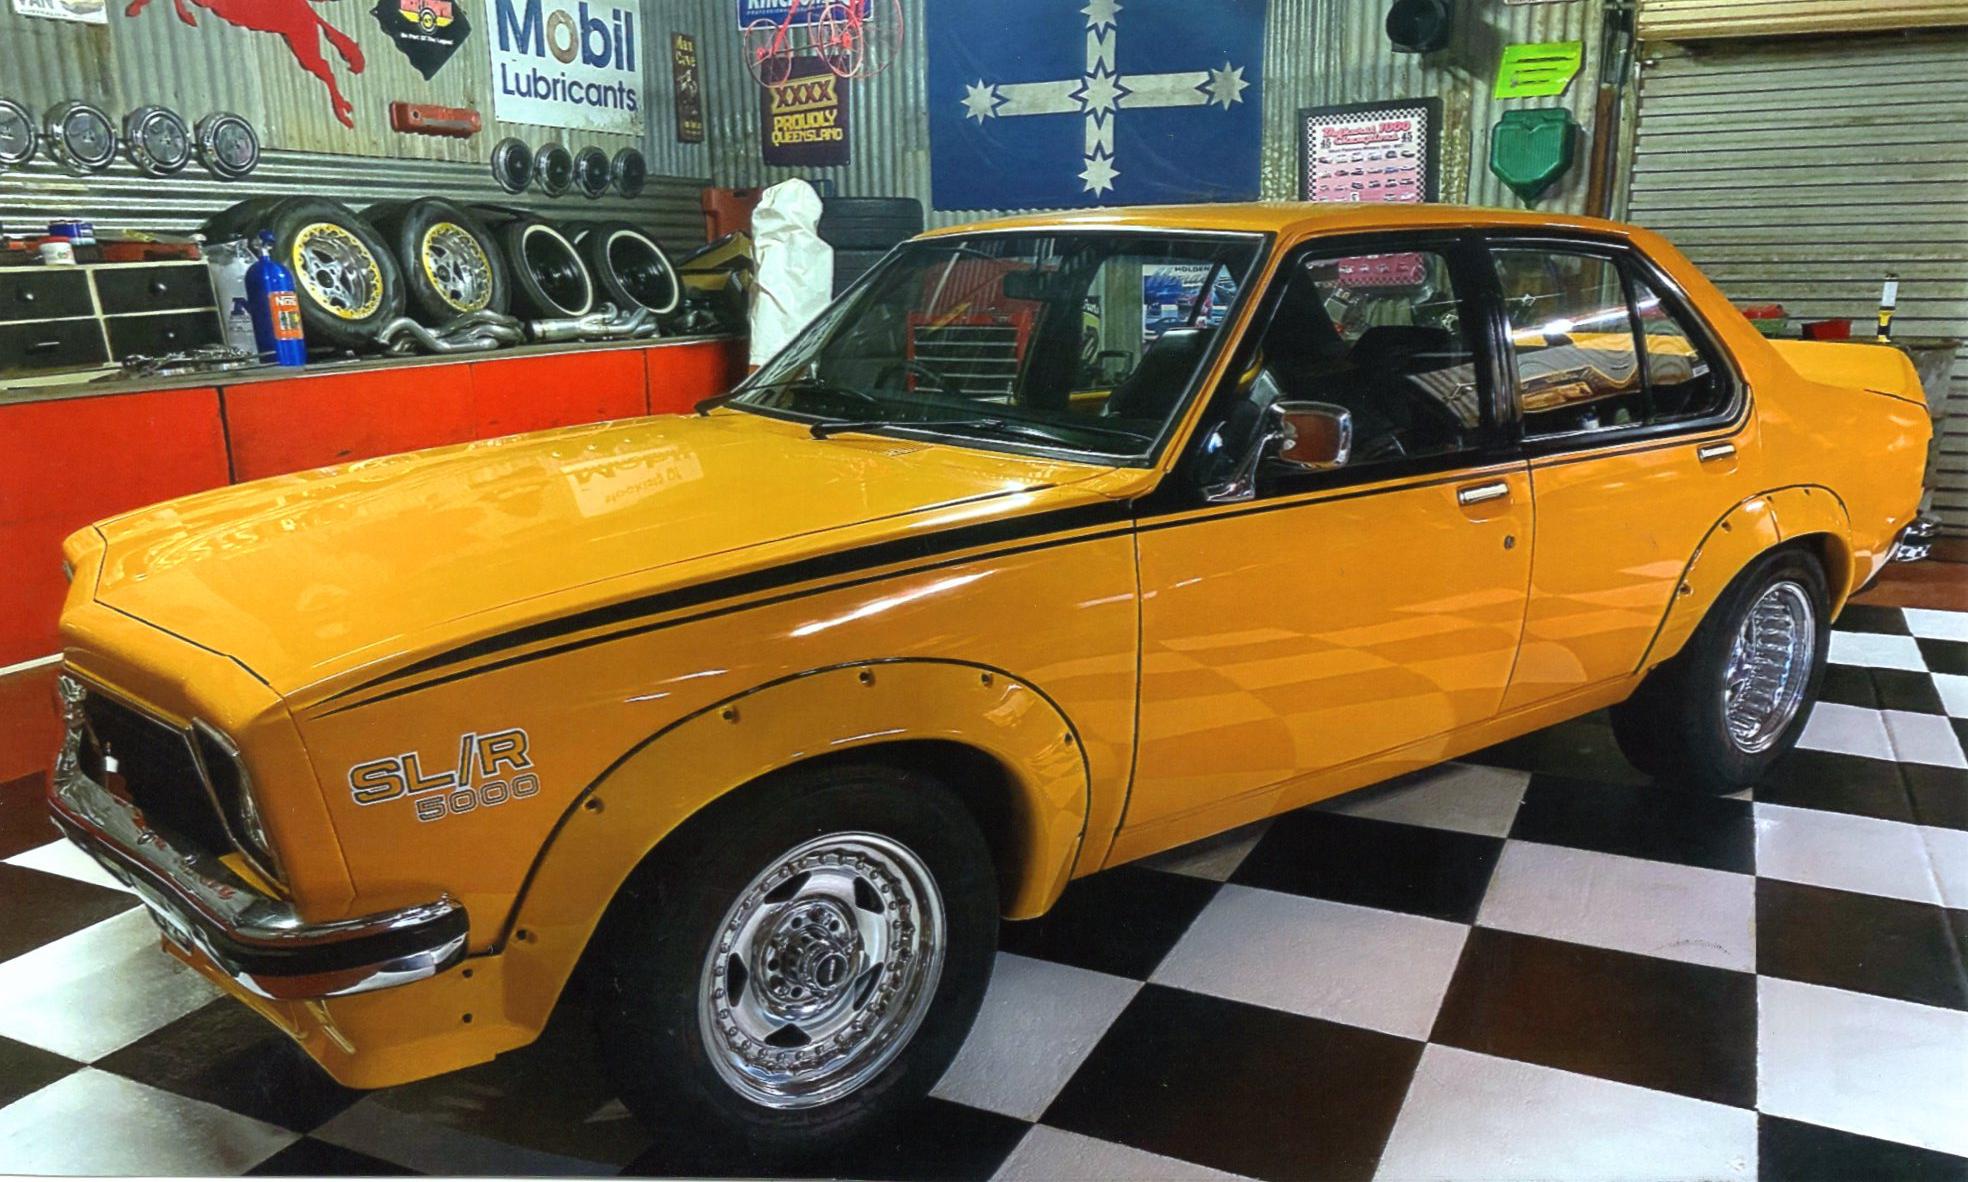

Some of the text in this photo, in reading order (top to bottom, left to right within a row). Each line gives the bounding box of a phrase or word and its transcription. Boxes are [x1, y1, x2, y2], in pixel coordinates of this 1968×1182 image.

[495, 0, 635, 72] Mobil
[501, 62, 637, 112] Lubricants
[776, 80, 832, 108] XXXX
[771, 128, 843, 147] QUEENSLAND
[774, 109, 837, 132] PROUDLY
[348, 728, 534, 806] SL/R
[415, 772, 540, 822] 5000
